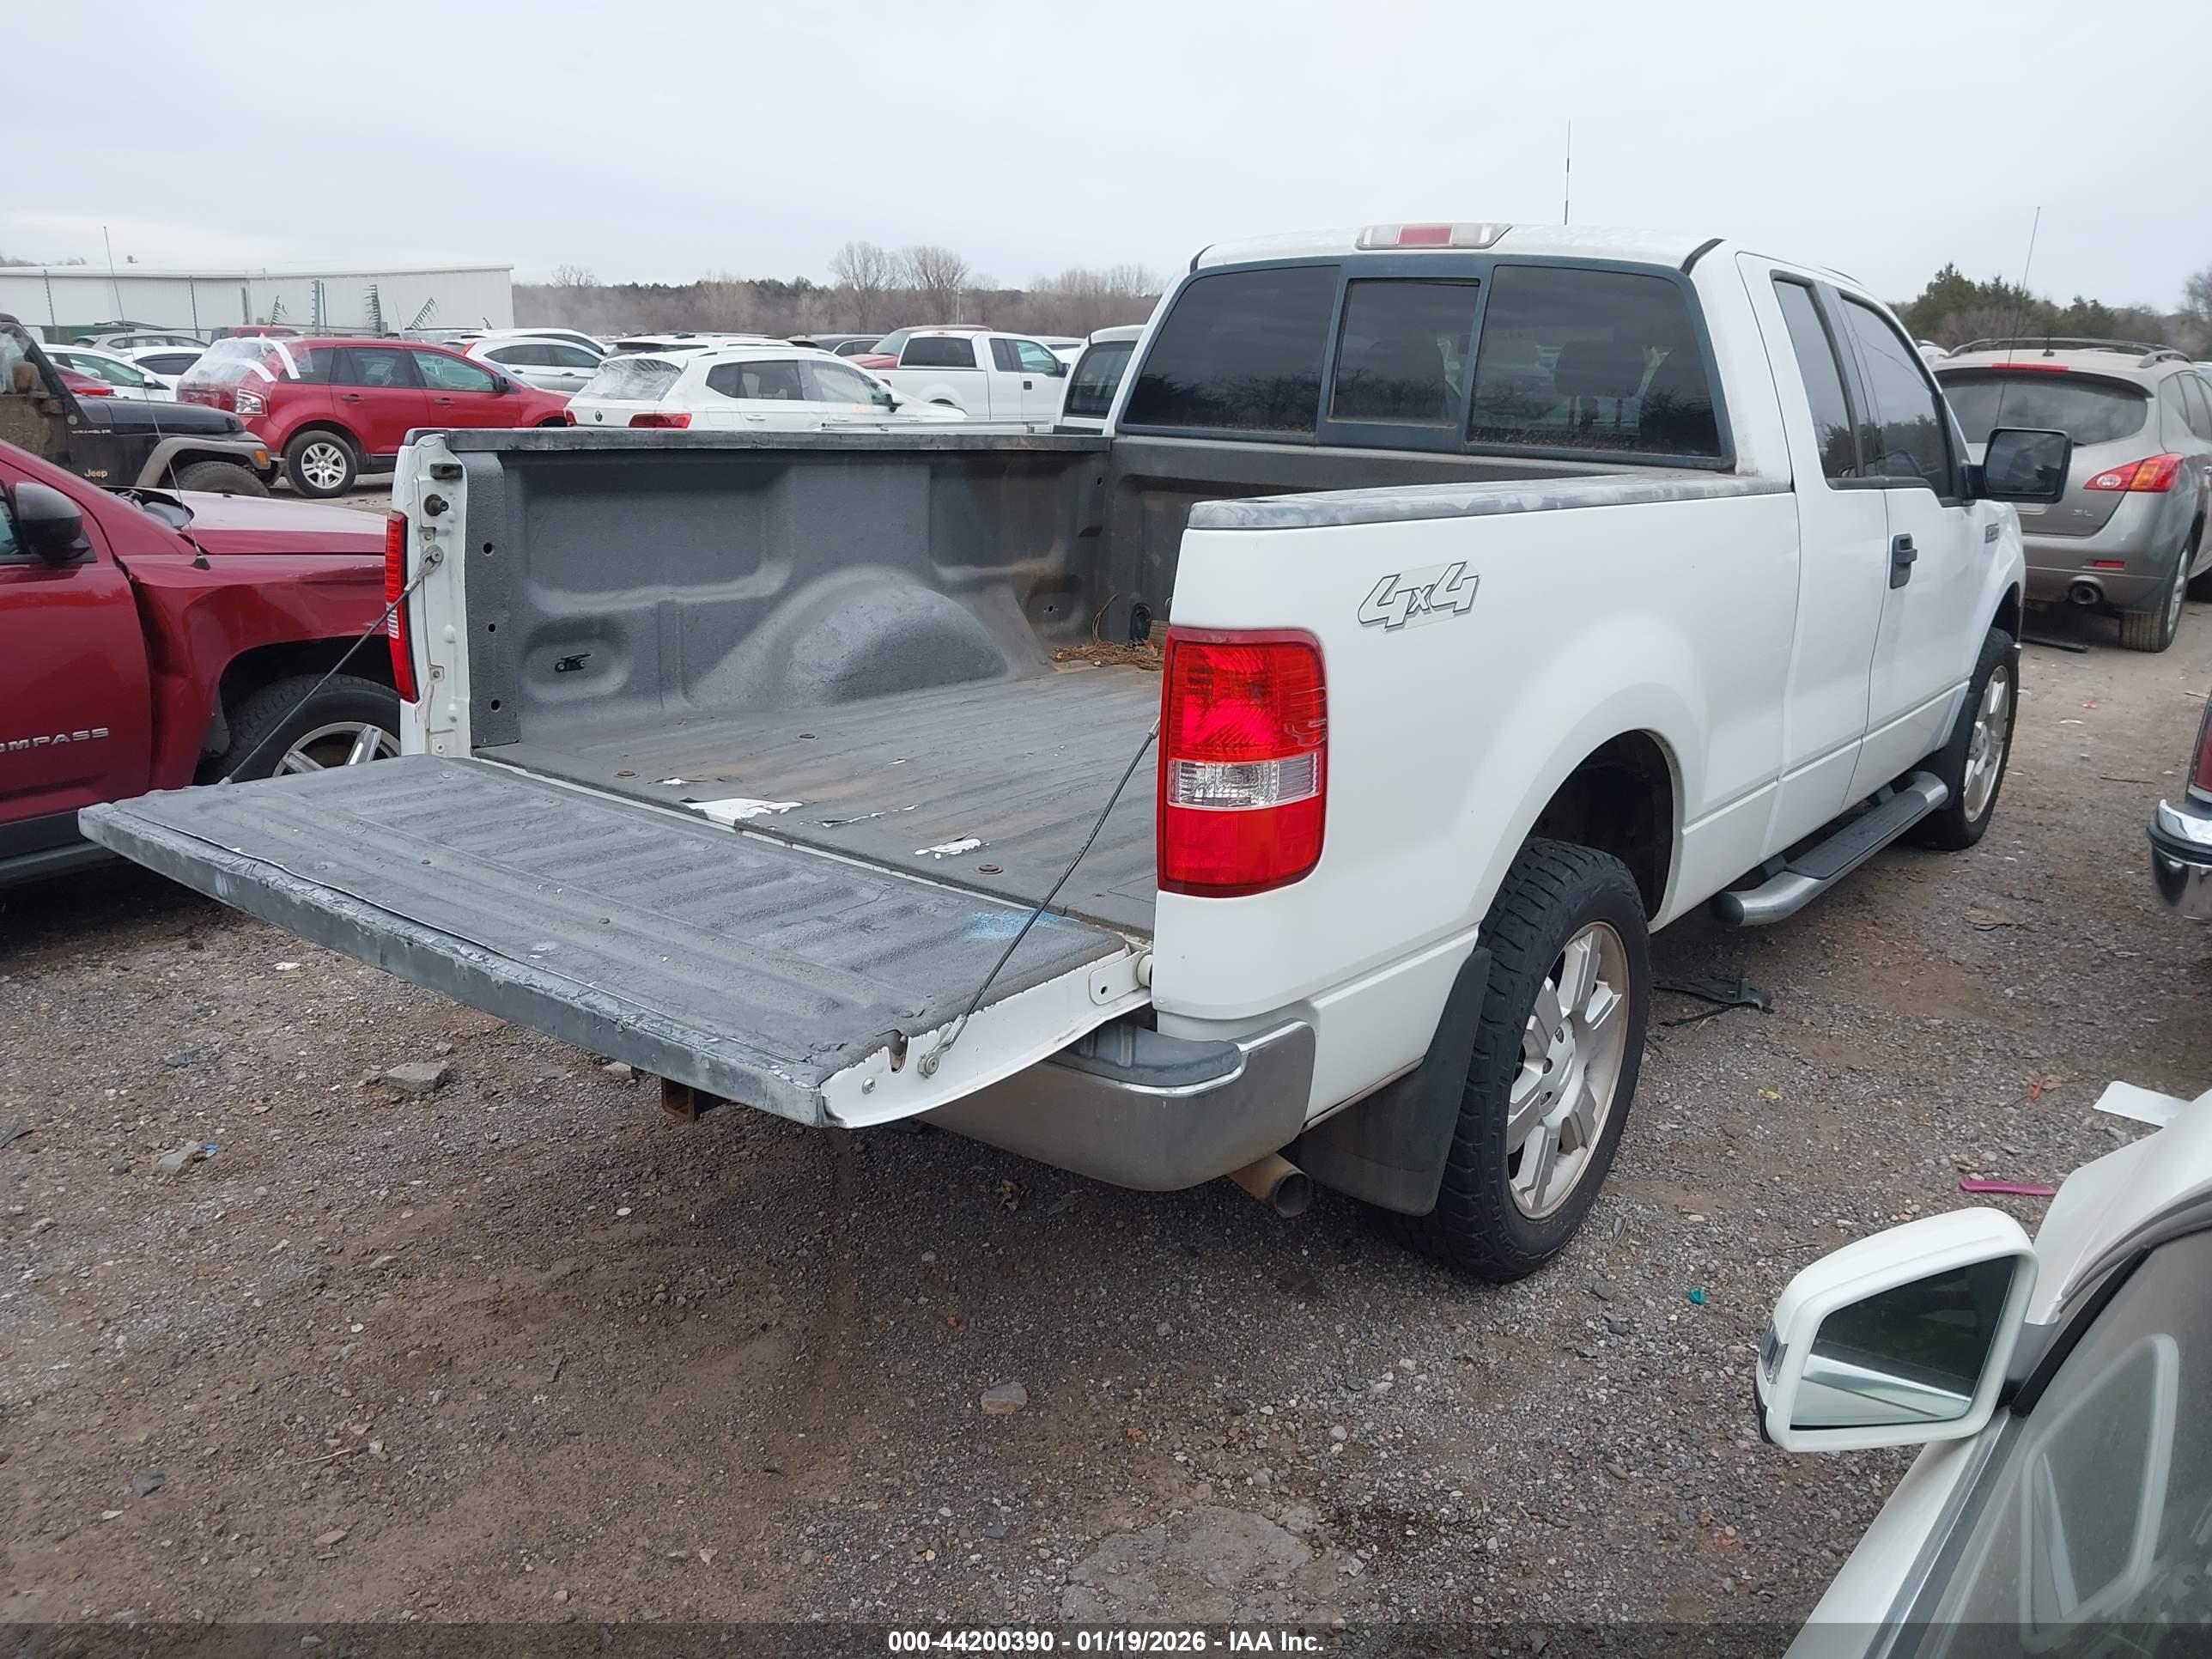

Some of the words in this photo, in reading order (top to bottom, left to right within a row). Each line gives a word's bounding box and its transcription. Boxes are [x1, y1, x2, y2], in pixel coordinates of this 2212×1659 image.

[84, 469, 108, 479] Jeep
[1358, 561, 1480, 632] 4x4
[0, 727, 109, 753] MPASS
